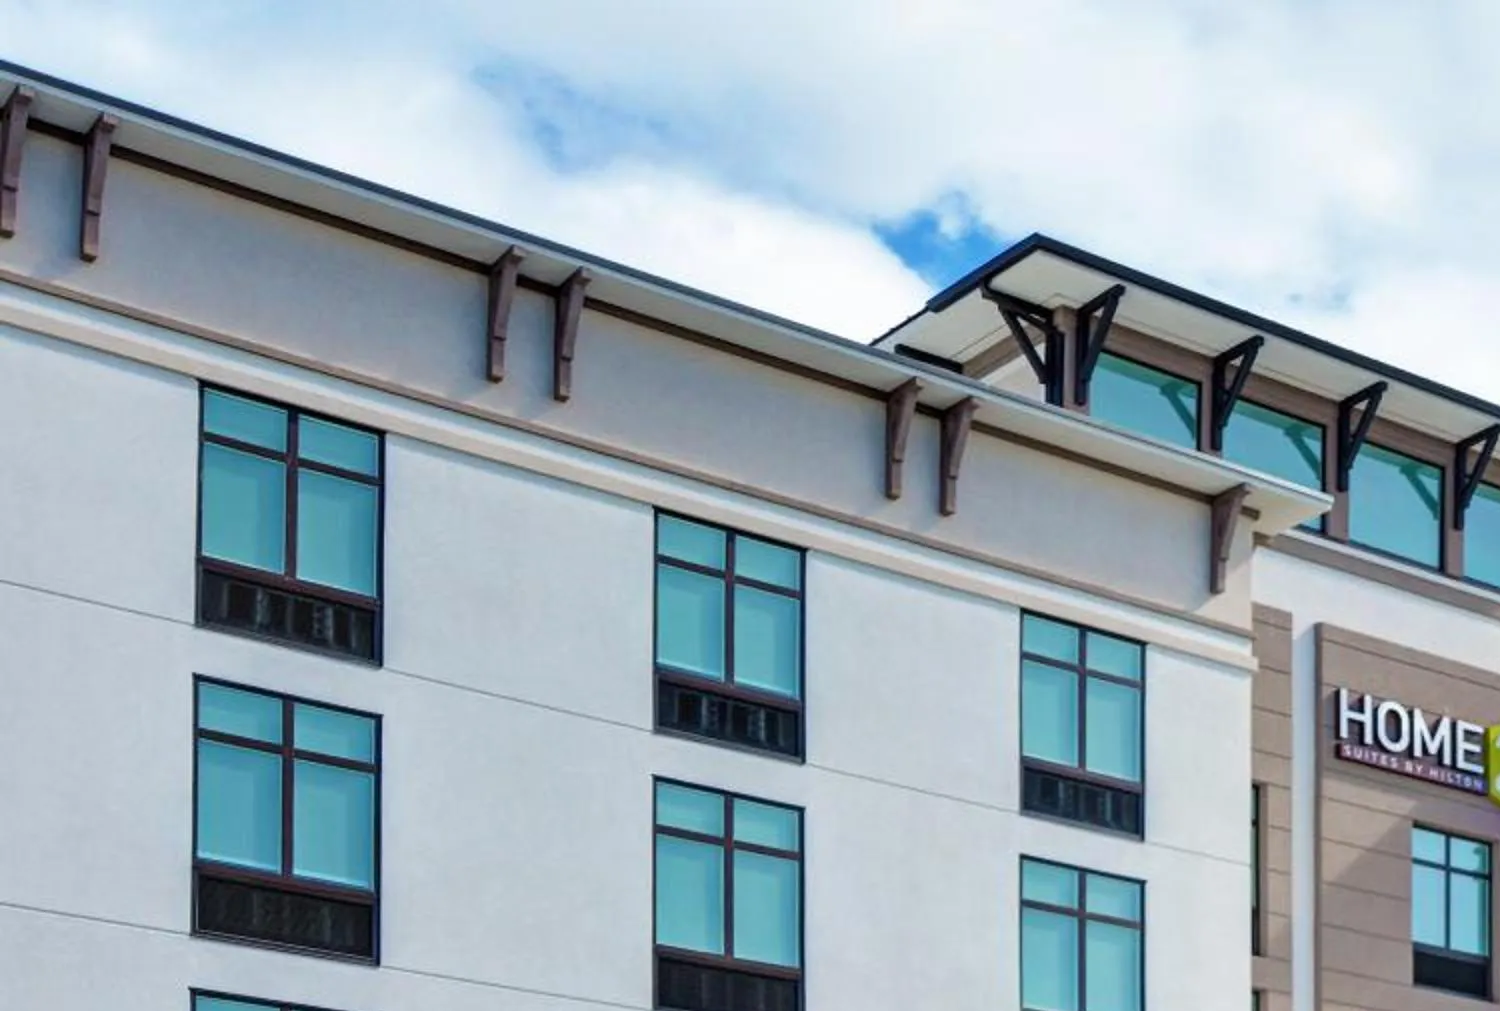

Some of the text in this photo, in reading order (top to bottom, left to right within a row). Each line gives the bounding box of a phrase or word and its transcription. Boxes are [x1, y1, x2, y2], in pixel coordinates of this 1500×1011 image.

[1339, 688, 1484, 773] HOME
[1343, 745, 1485, 791] SUITES BY HILTON
